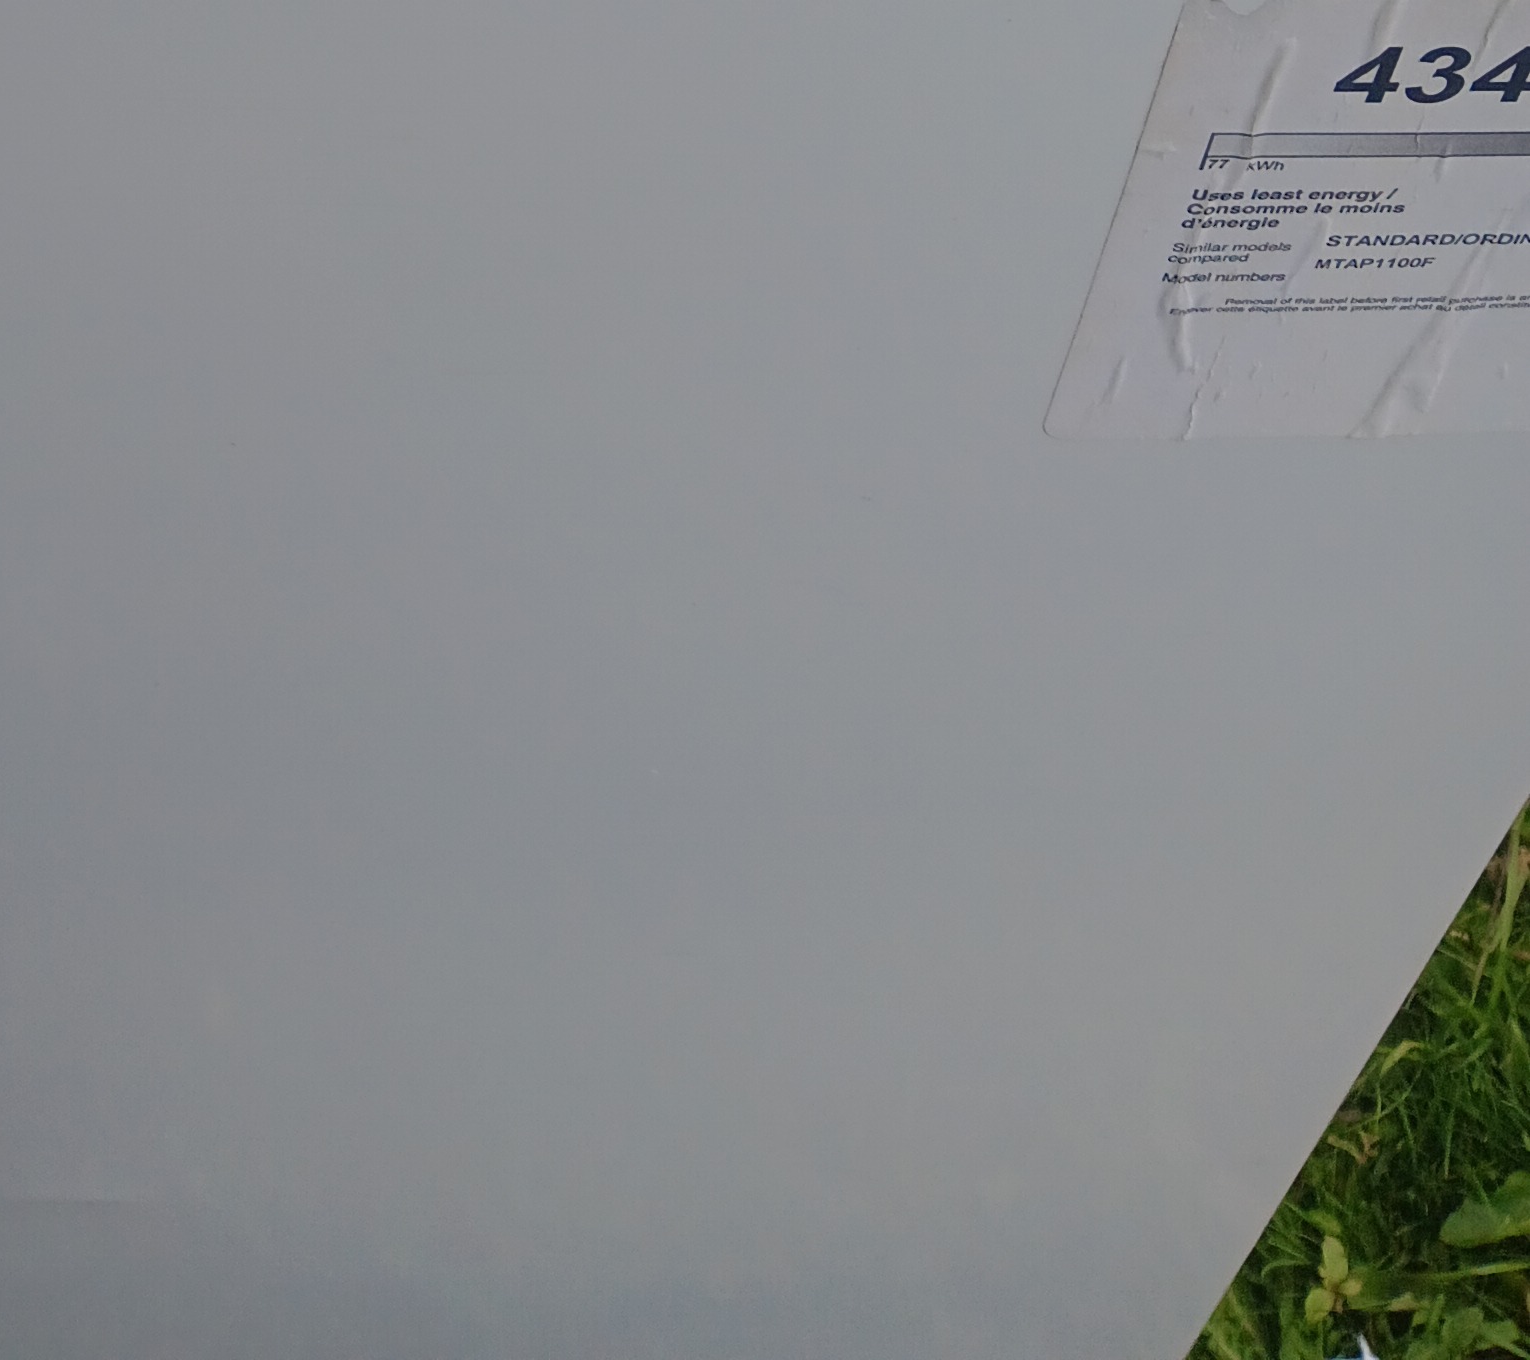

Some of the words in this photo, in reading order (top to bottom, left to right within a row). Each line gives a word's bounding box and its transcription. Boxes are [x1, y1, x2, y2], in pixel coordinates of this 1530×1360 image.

[1333, 46, 1530, 104] 434
[1192, 189, 1244, 201] Uses
[1250, 188, 1303, 200] least
[1308, 189, 1382, 202] energy
[1186, 203, 1308, 215] Consomme
[1313, 202, 1333, 214] le
[1339, 202, 1406, 214] moins
[1181, 218, 1280, 230] d'énergie
[1172, 242, 1229, 254] Similar
[1237, 241, 1292, 252] models
[1167, 253, 1250, 265] compared
[1315, 257, 1436, 269] MTAP1100F
[1162, 272, 1211, 284] Model
[1215, 271, 1286, 282] numbers
